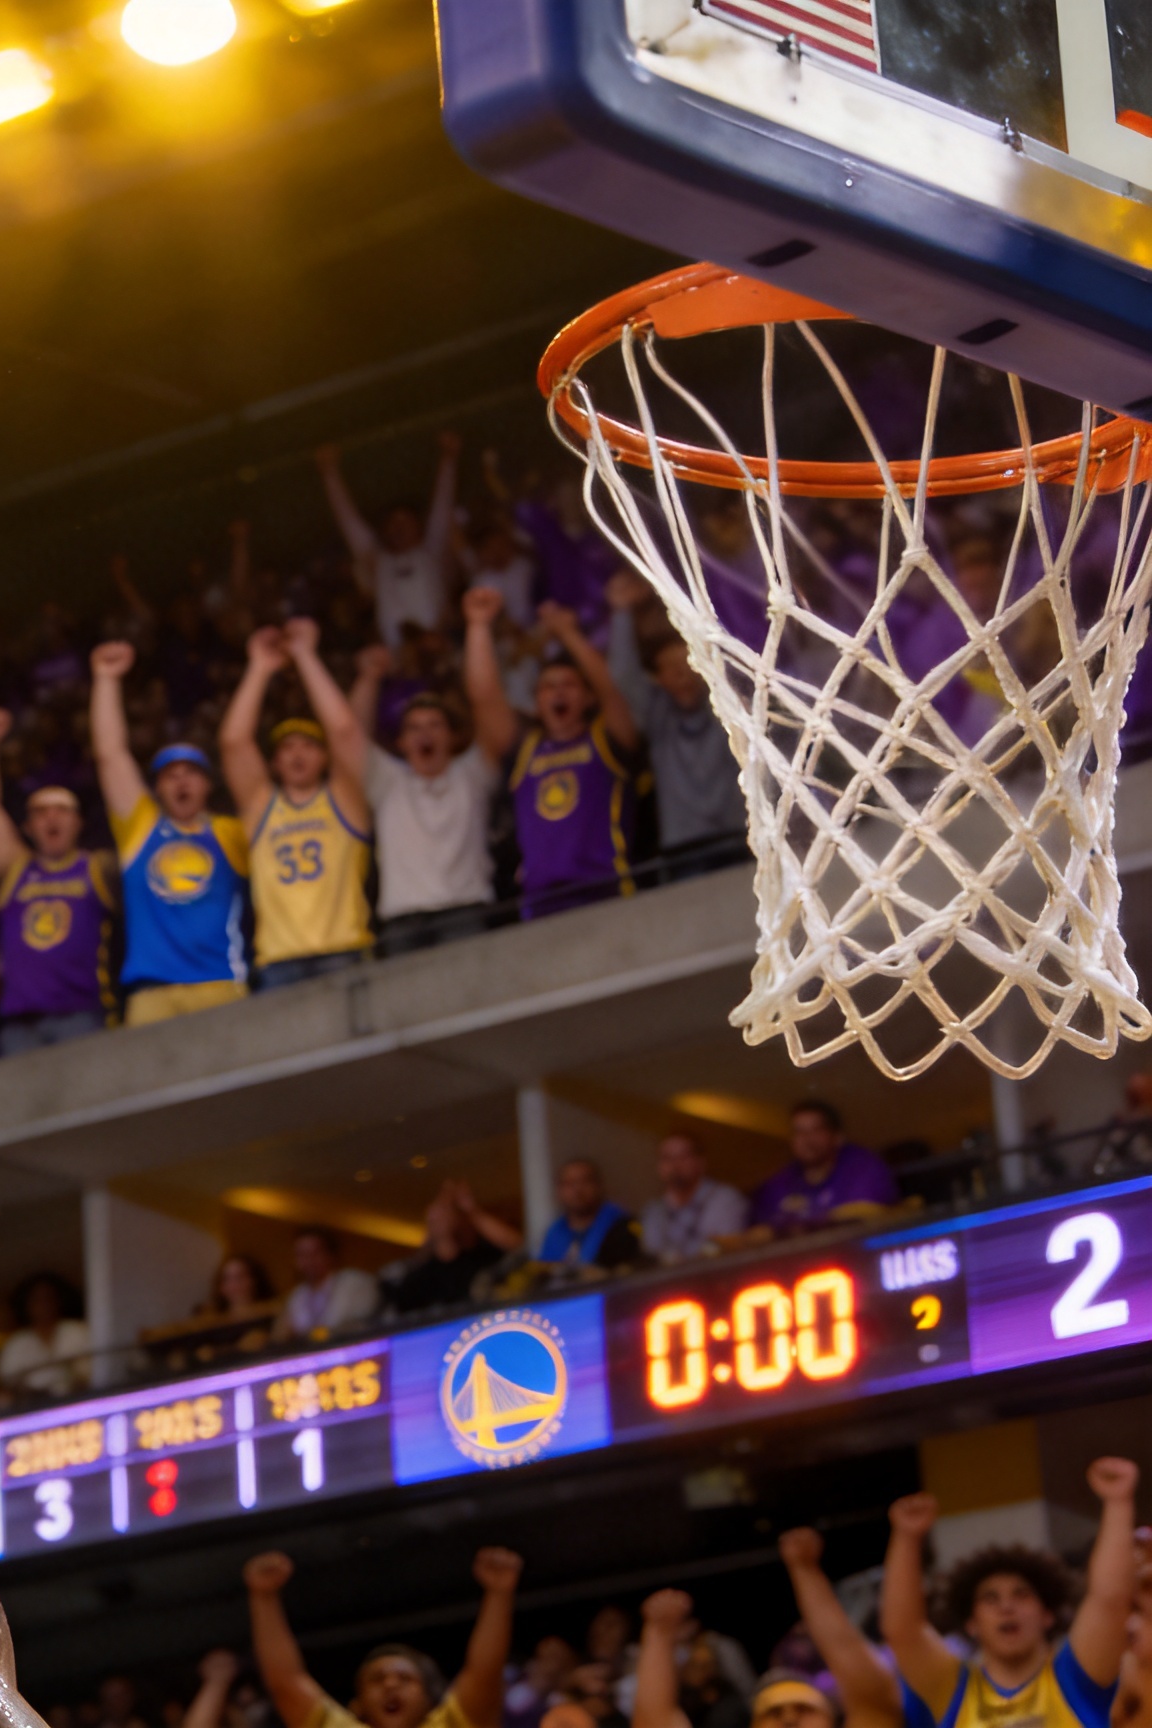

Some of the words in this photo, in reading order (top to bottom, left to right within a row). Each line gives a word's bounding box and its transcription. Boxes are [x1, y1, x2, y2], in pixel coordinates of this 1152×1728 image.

[1047, 1211, 1130, 1340] 2
[646, 1267, 857, 1409] 0:00
[292, 1427, 324, 1492] 1
[35, 1479, 74, 1542] 3
